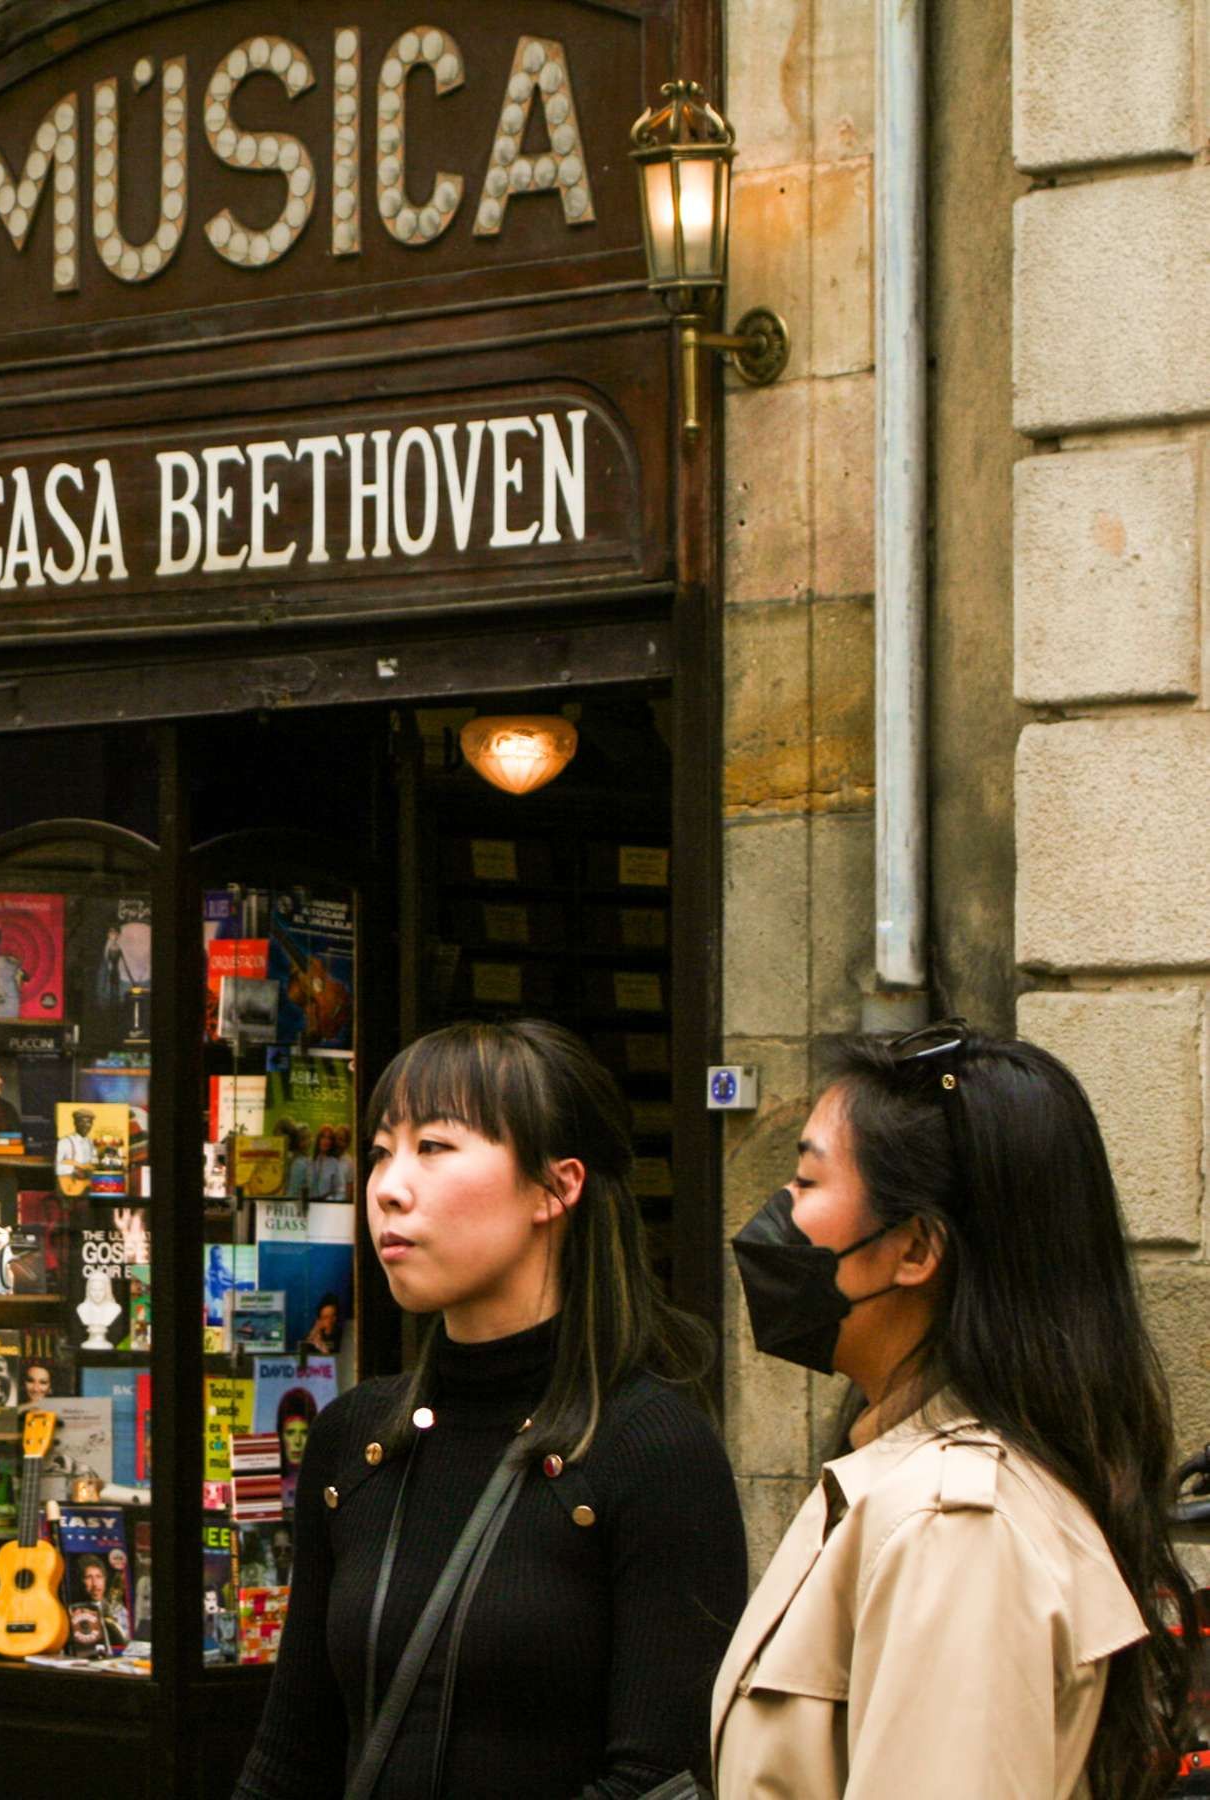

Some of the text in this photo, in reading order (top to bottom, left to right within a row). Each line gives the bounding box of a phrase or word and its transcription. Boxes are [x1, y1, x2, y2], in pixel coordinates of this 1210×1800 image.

[156, 409, 589, 577] BEETHOVEN
[9, 1037, 55, 1049] PUCCINI
[289, 1071, 319, 1085] ABBA
[292, 1087, 347, 1103] CLASSICS
[265, 1219, 308, 1231] GLASS
[81, 1230, 106, 1241] THE
[260, 1364, 294, 1378] DAVID
[59, 1515, 117, 1529] EASY
